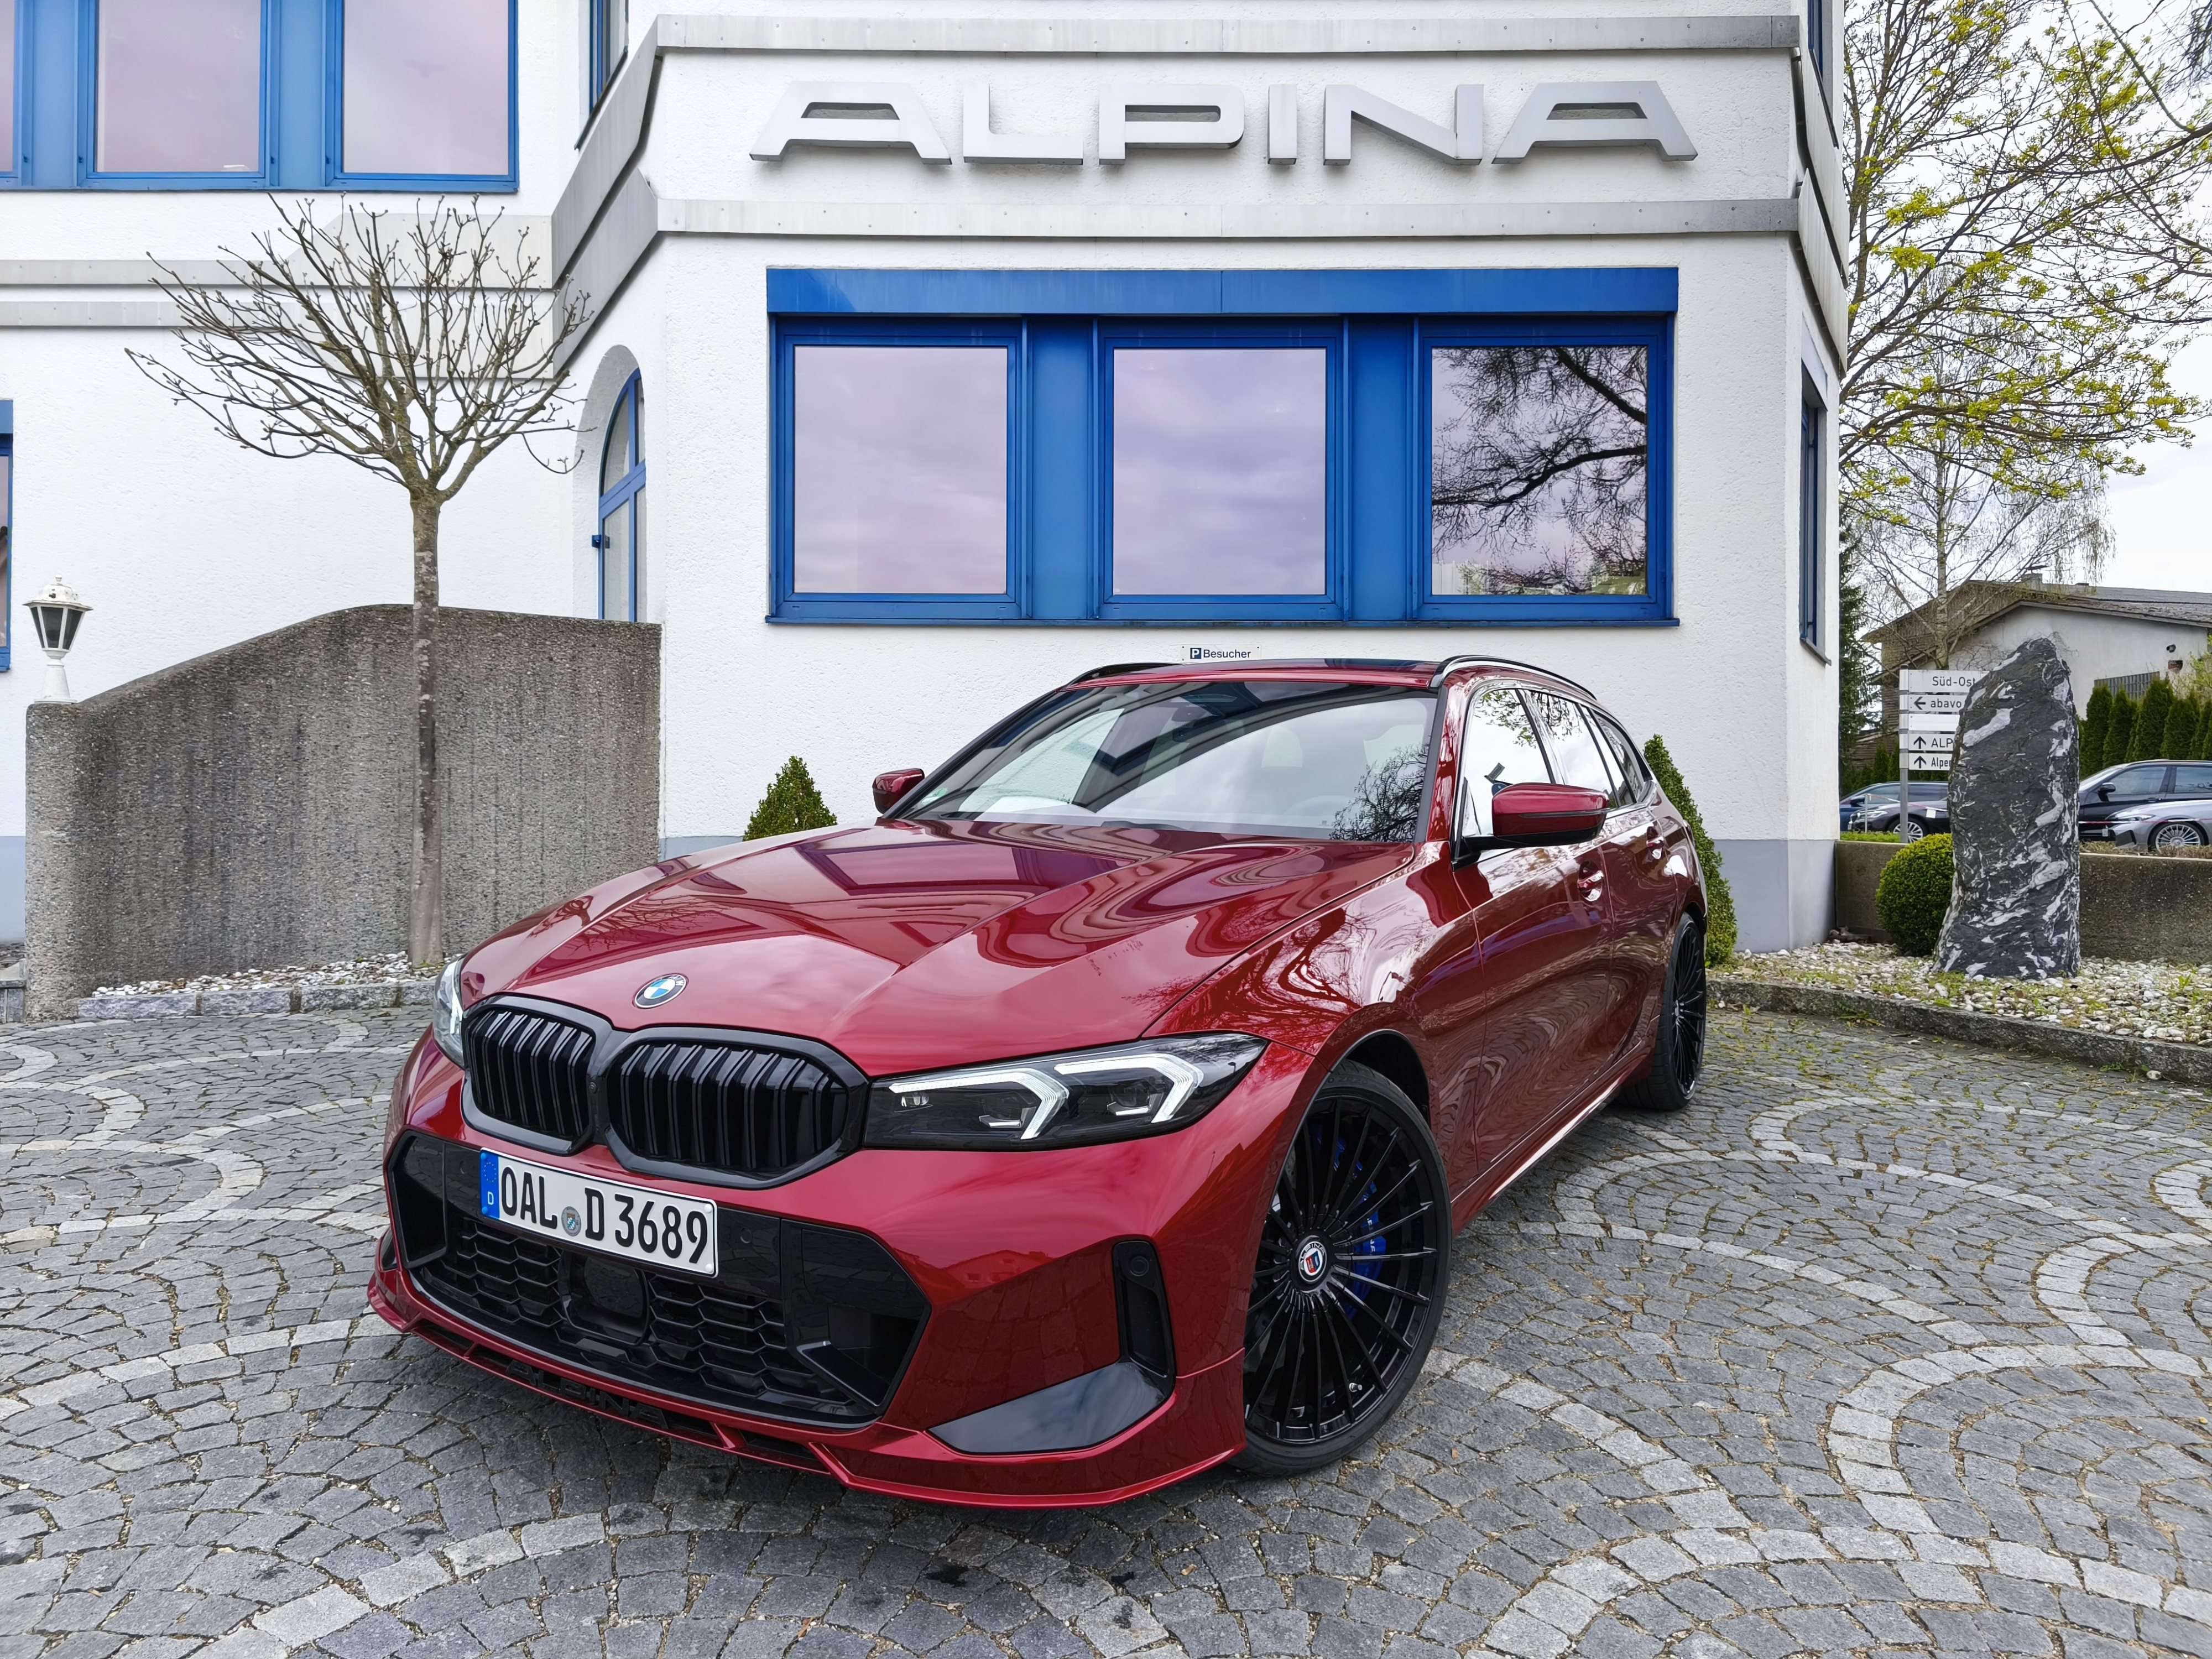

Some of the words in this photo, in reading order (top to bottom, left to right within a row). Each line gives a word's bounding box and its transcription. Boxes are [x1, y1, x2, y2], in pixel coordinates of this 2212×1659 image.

[749, 81, 1698, 165] ALPINA
[1192, 649, 1199, 658] P
[1203, 649, 1251, 658] Besucher
[1931, 698, 1962, 708] abavo
[487, 1191, 494, 1206] D
[501, 1166, 558, 1229] OAL
[585, 1187, 604, 1241] D
[614, 1194, 708, 1264] 3689
[1300, 1243, 1326, 1270] ALPINA
